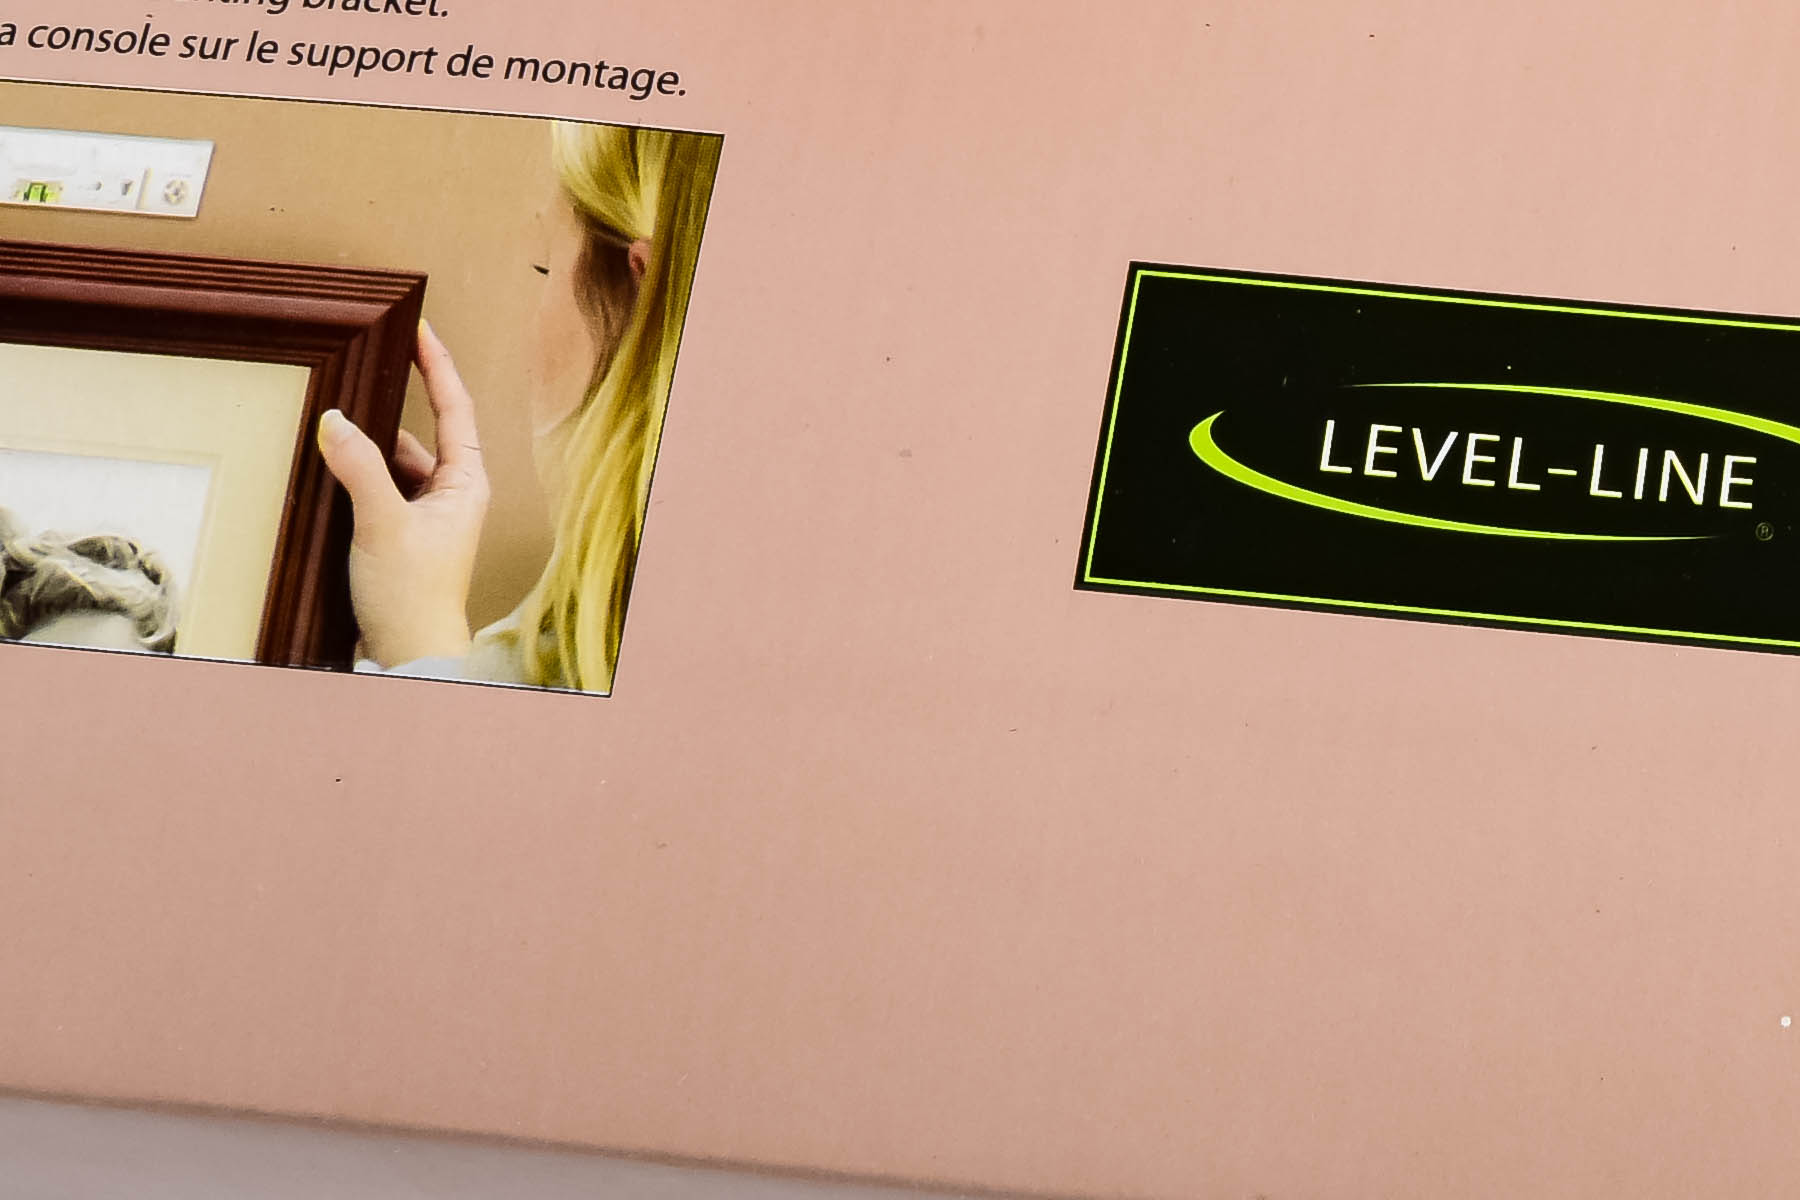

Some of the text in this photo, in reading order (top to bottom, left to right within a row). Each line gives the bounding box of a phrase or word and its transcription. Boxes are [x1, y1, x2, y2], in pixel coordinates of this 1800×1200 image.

[27, 22, 171, 57] console
[178, 35, 240, 61] sur
[245, 30, 279, 64] le
[286, 42, 439, 77] support
[445, 44, 495, 79] de
[503, 57, 688, 101] montage.
[1318, 418, 1758, 511] LEVEL-LINE
